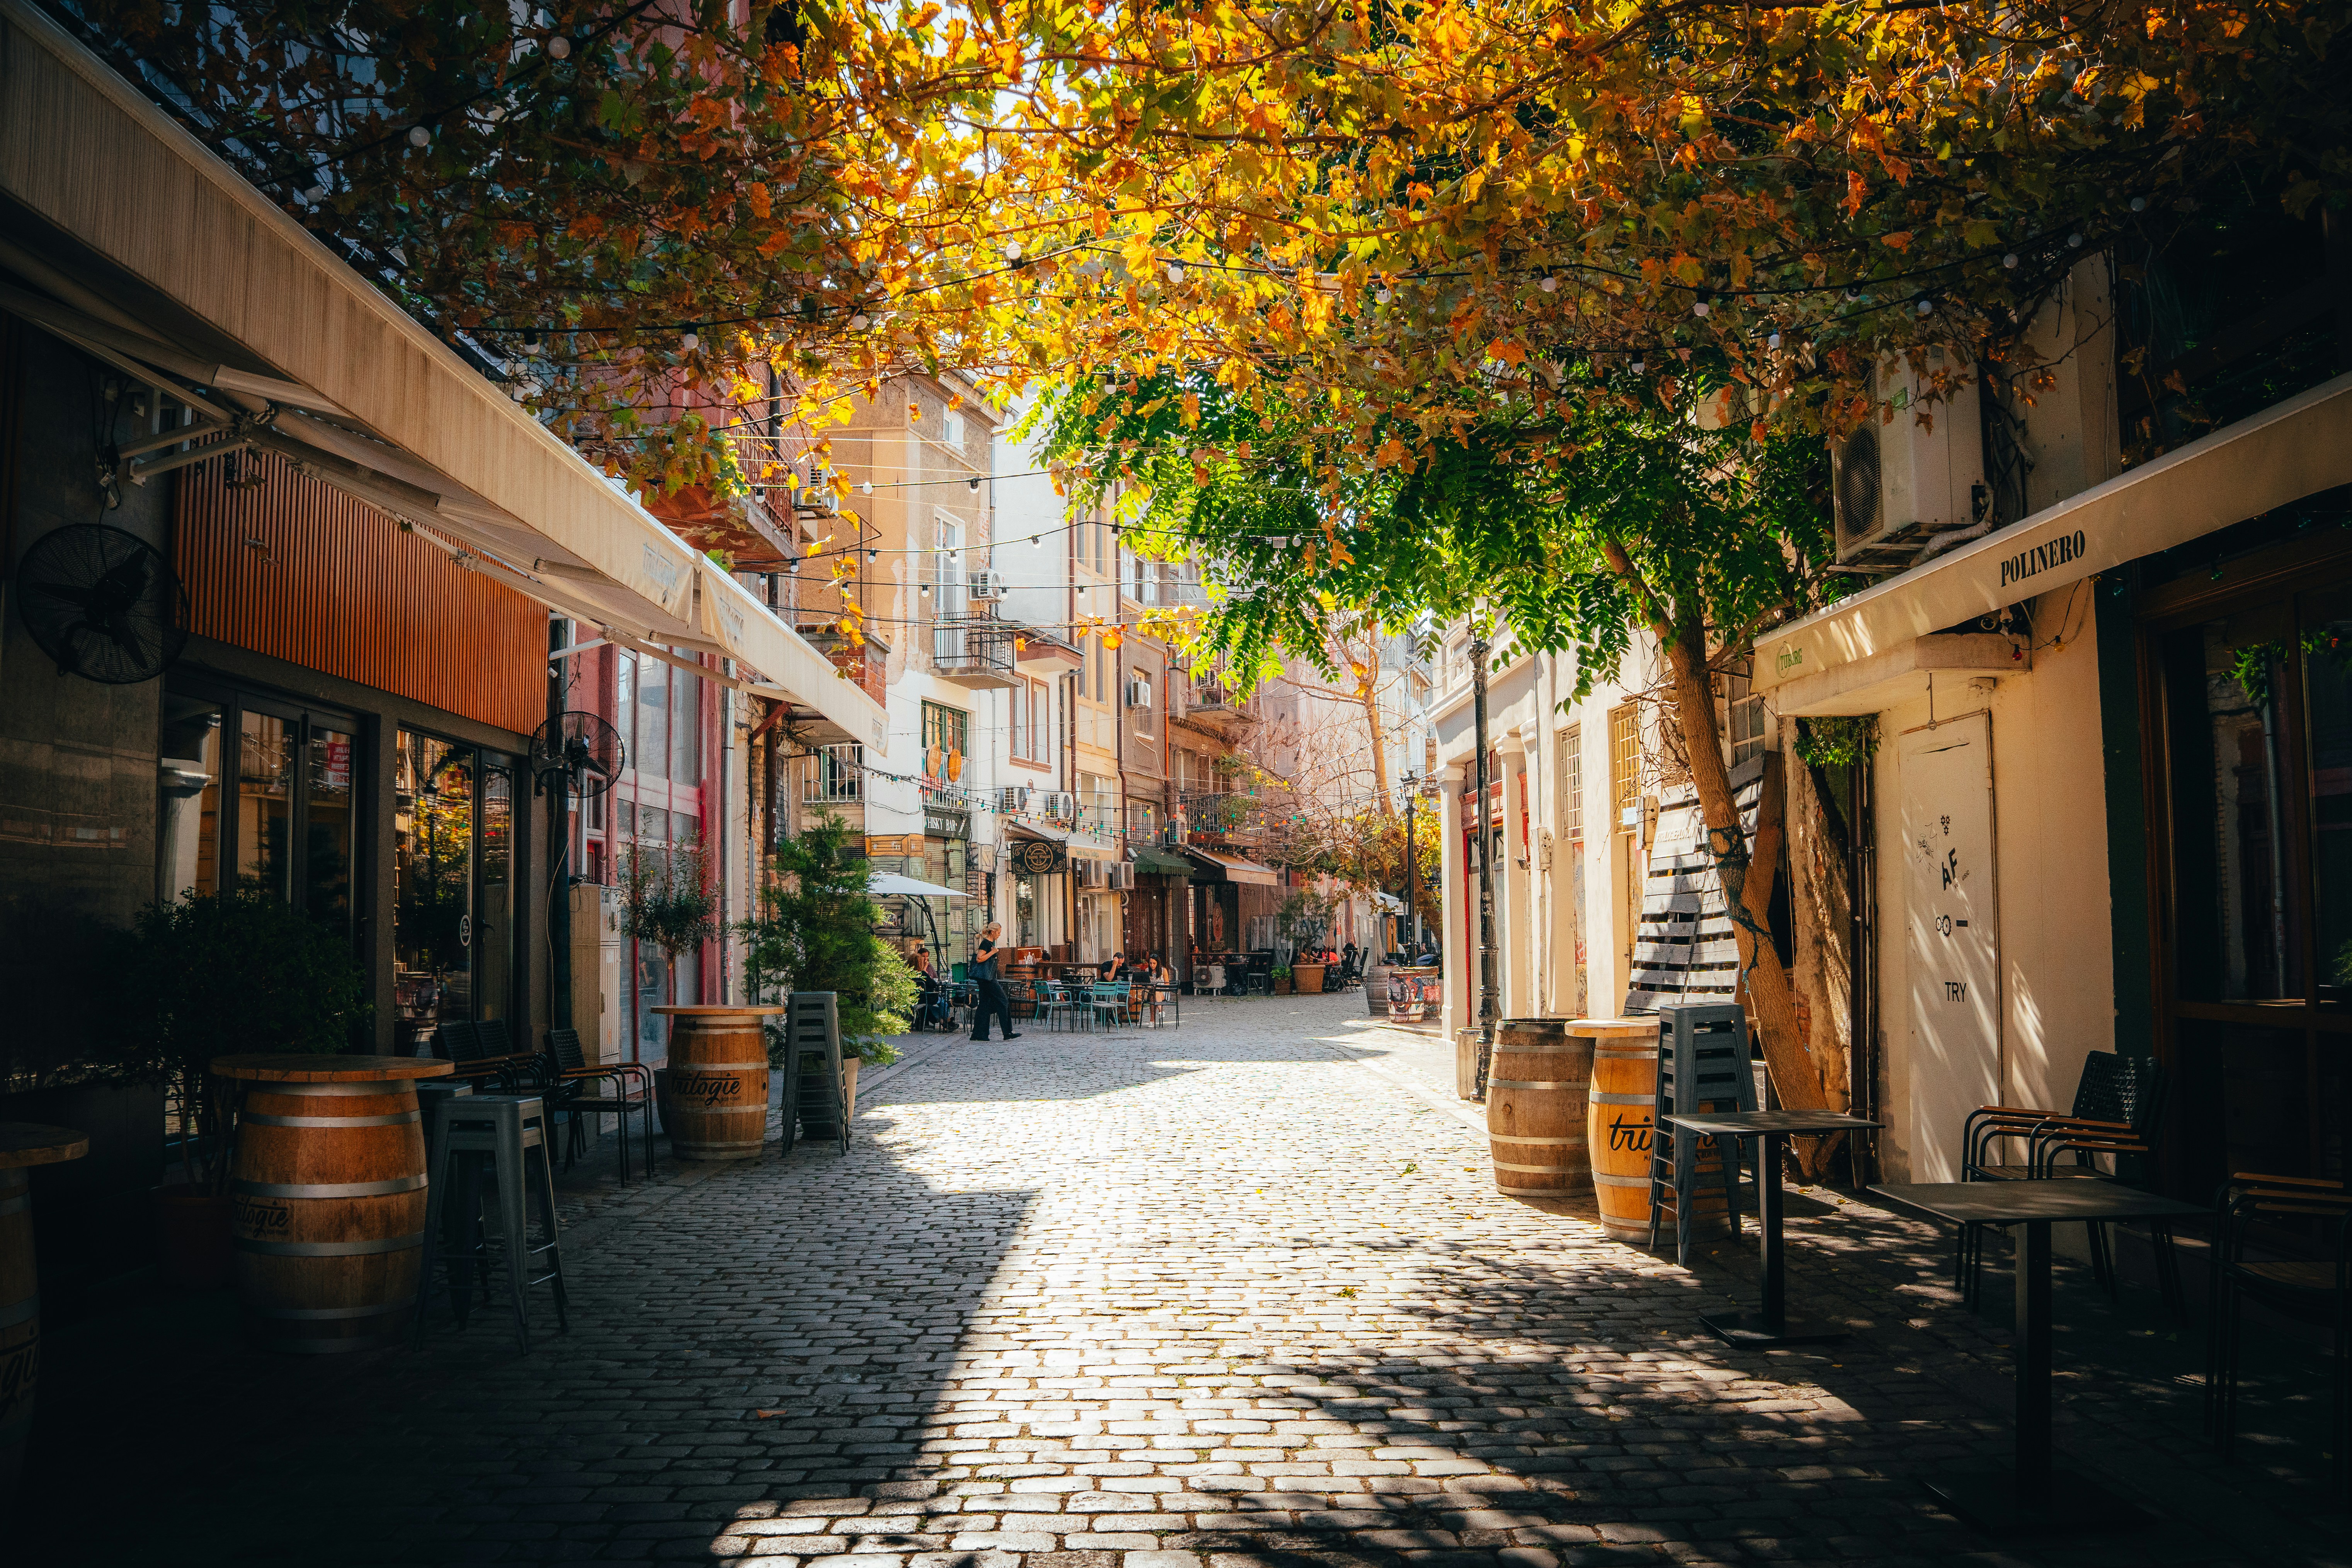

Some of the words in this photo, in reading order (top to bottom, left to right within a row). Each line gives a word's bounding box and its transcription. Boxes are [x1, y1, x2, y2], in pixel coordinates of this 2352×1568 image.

[2001, 530, 2085, 587] POLINERO
[1780, 648, 1802, 670] TUBORG
[946, 819, 956, 831] BAR
[1945, 982, 1967, 1002] TRY
[672, 1070, 741, 1106] trilogie
